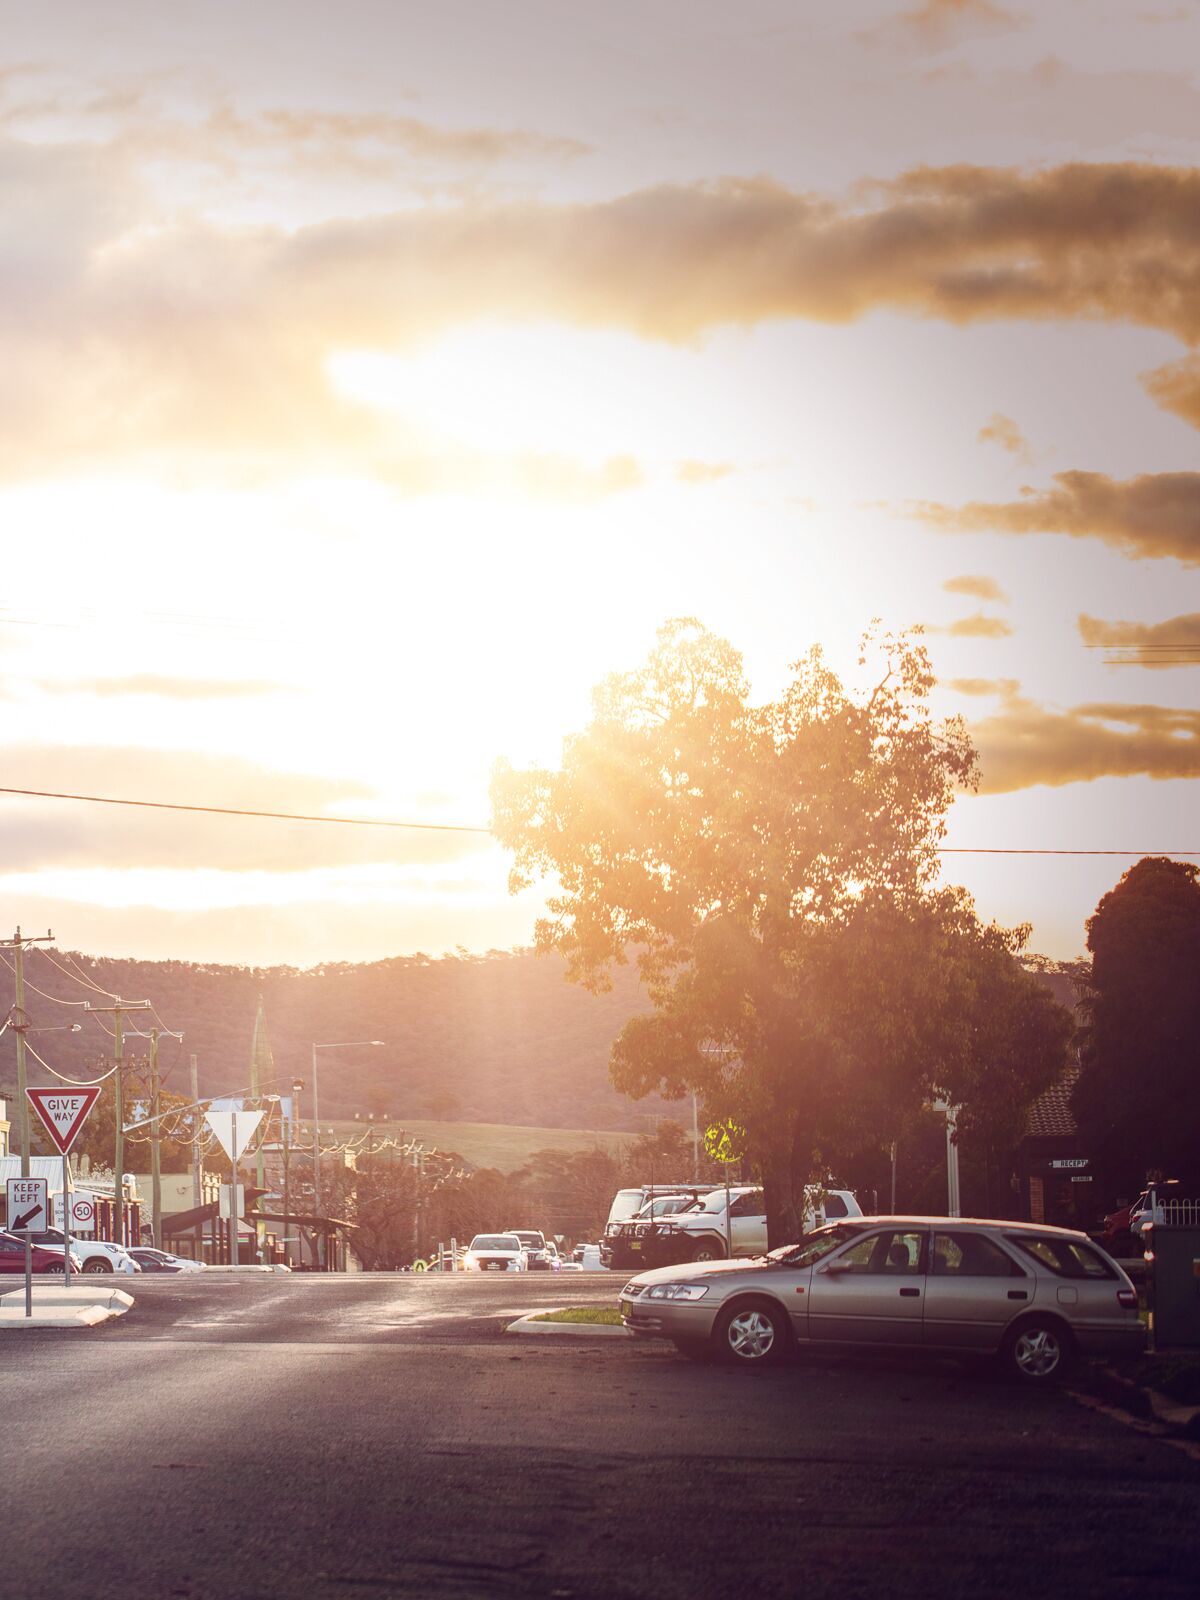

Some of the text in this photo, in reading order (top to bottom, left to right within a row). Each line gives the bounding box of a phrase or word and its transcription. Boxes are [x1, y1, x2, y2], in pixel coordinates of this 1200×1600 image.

[48, 1099, 79, 1110] GIVE
[54, 1112, 74, 1121] WAY
[13, 1183, 40, 1192] KEEP
[14, 1194, 38, 1203] LEFT
[76, 1206, 90, 1216] 50
